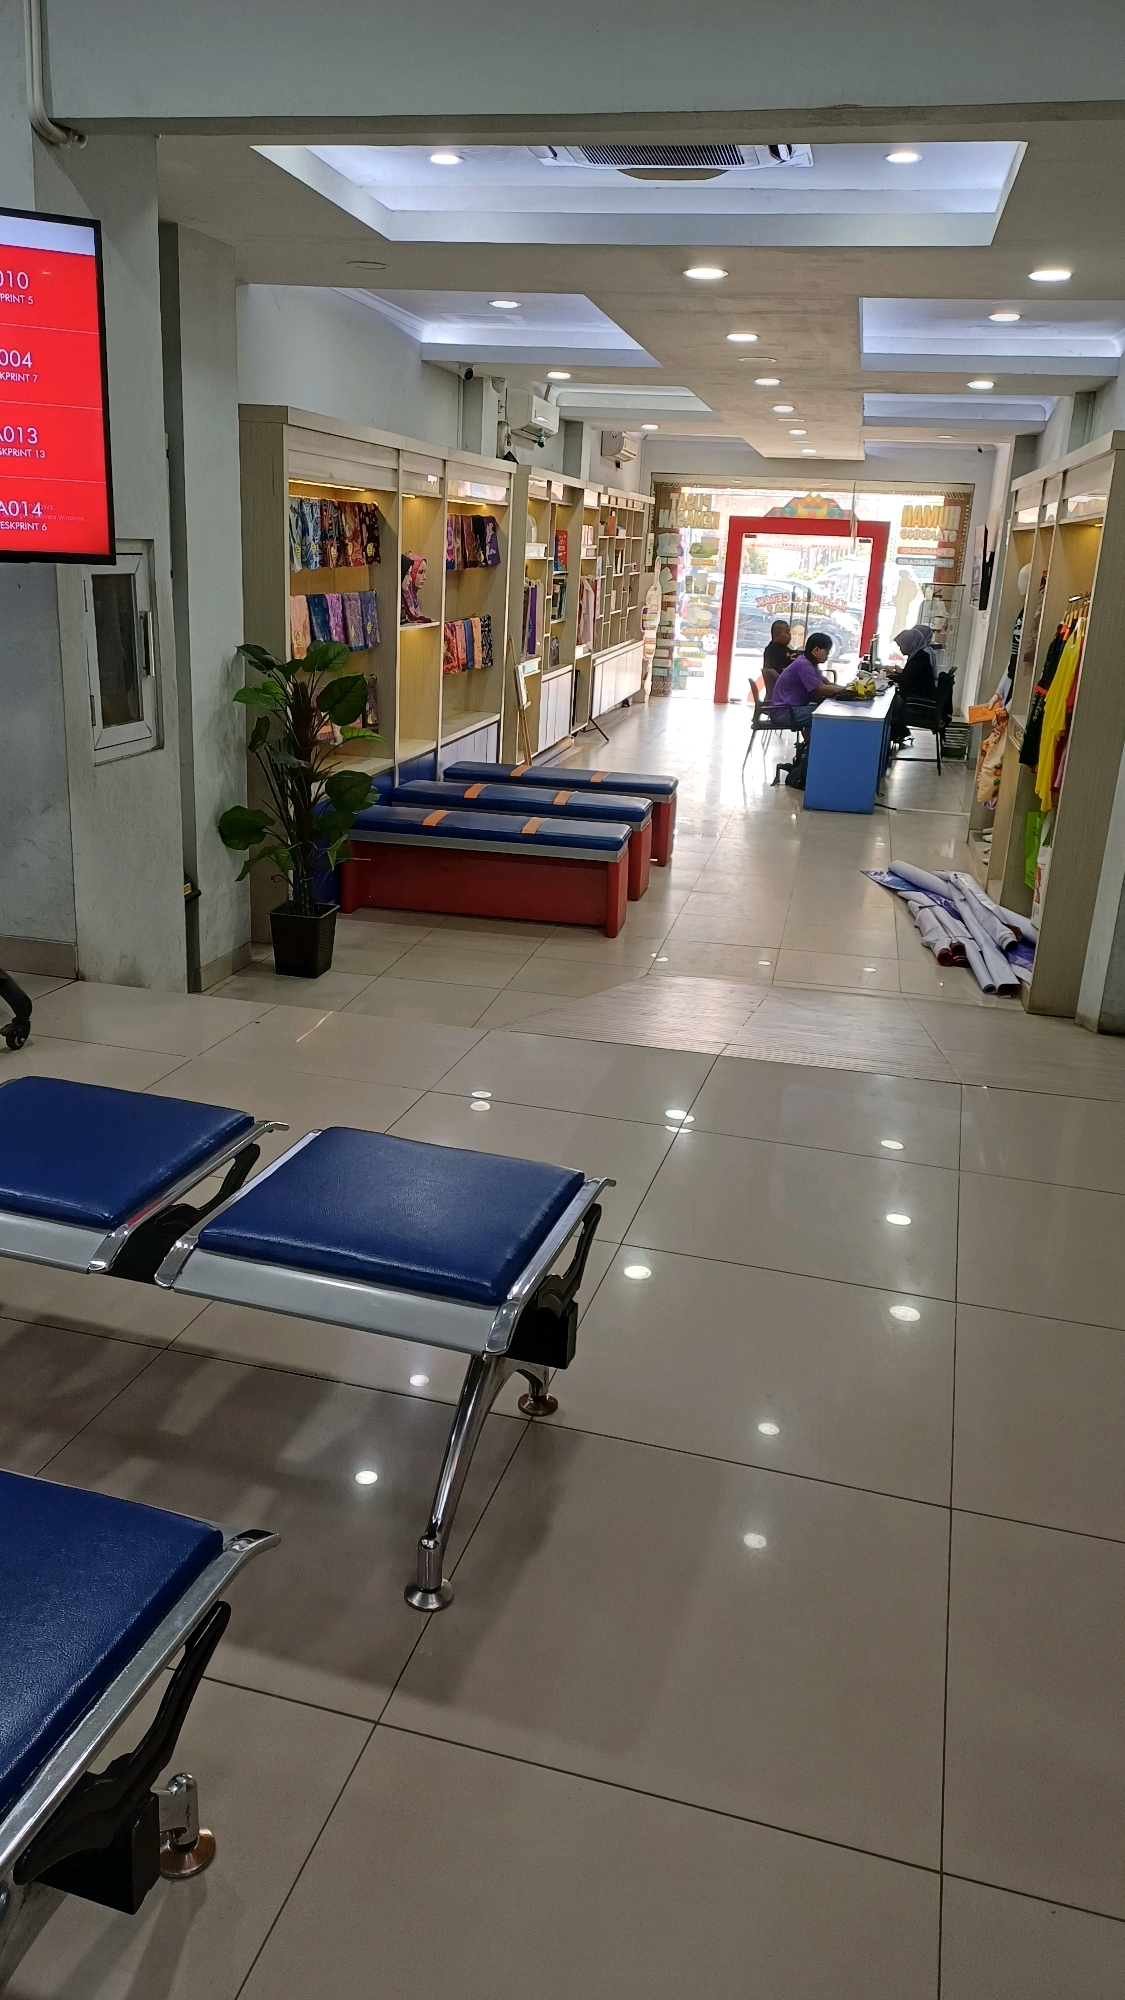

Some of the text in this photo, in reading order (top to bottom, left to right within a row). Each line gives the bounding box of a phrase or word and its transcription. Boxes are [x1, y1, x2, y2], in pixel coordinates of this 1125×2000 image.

[27, 295, 34, 305] 5
[32, 373, 38, 384] 7
[35, 449, 46, 459] 13
[41, 522, 48, 532] 6
